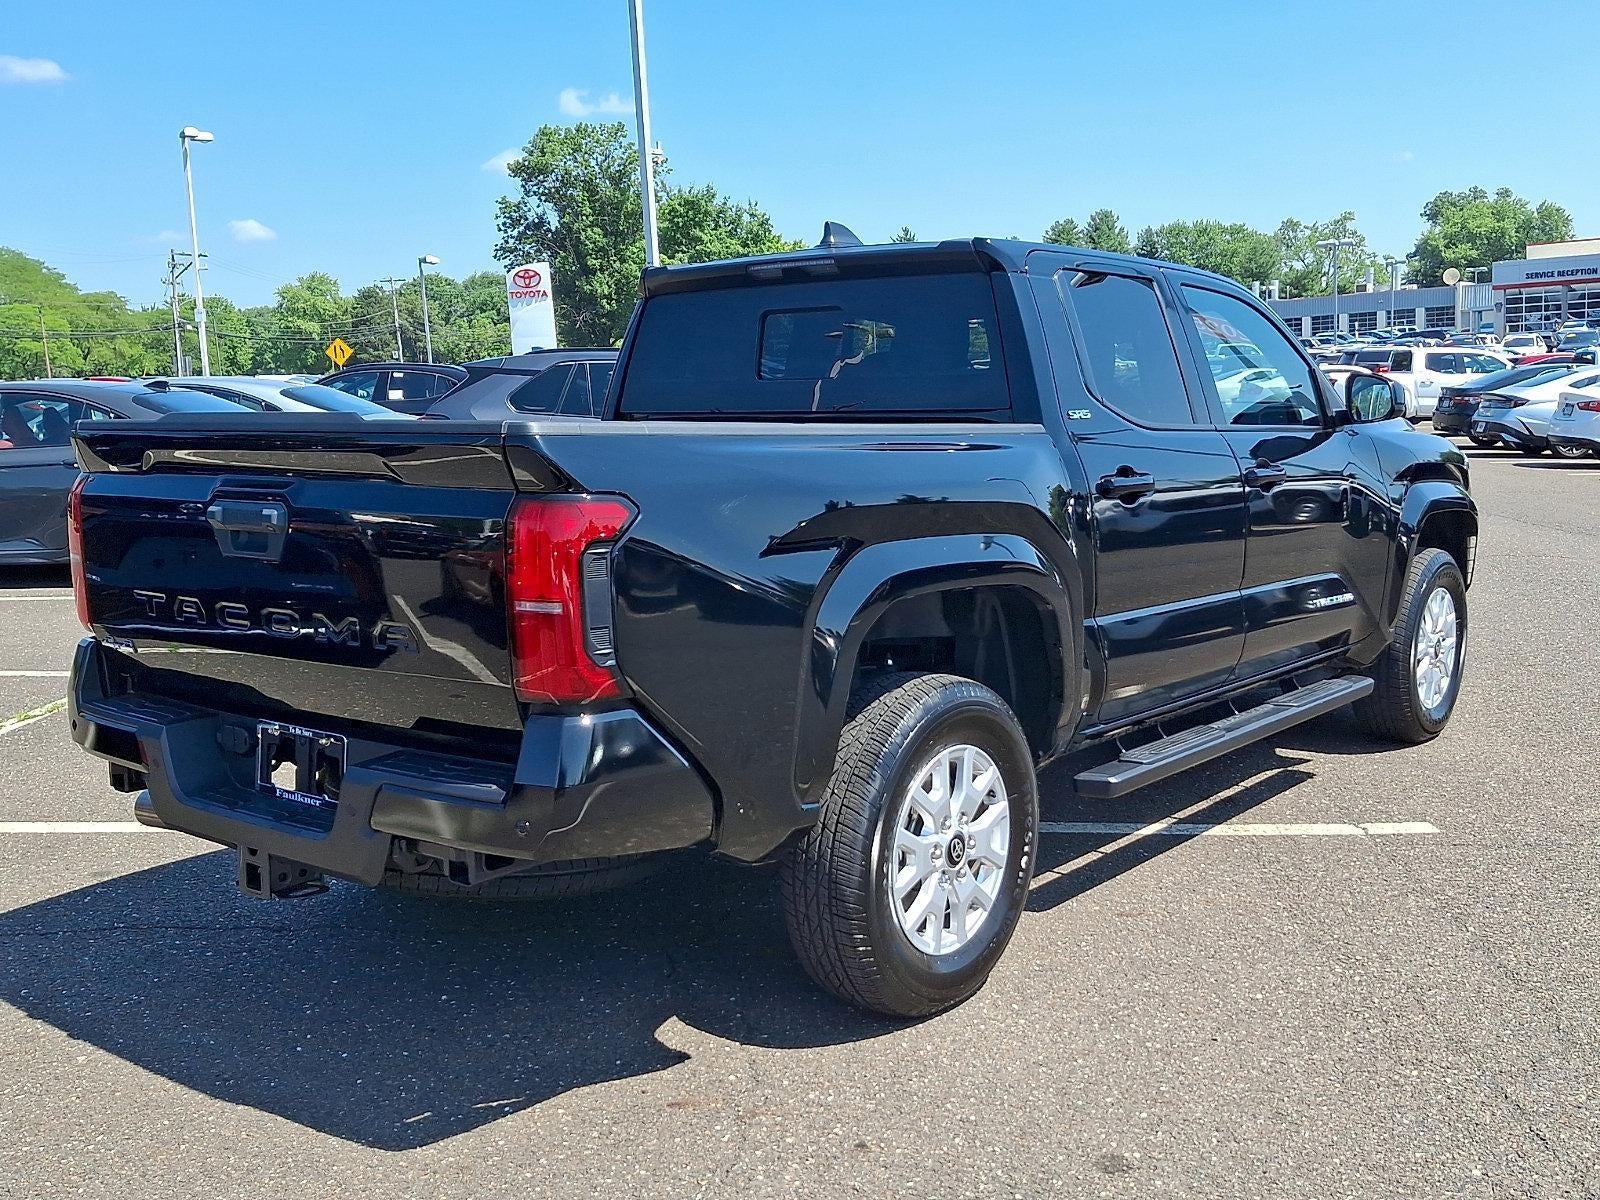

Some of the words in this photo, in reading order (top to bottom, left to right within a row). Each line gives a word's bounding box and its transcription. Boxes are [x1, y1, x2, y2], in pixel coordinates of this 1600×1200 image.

[1525, 270, 1555, 279] SERVICE
[1557, 267, 1598, 277] RECEPTION
[509, 290, 548, 299] TOYOTA
[133, 589, 420, 657] TACOMA
[276, 788, 322, 806] Faulkner
